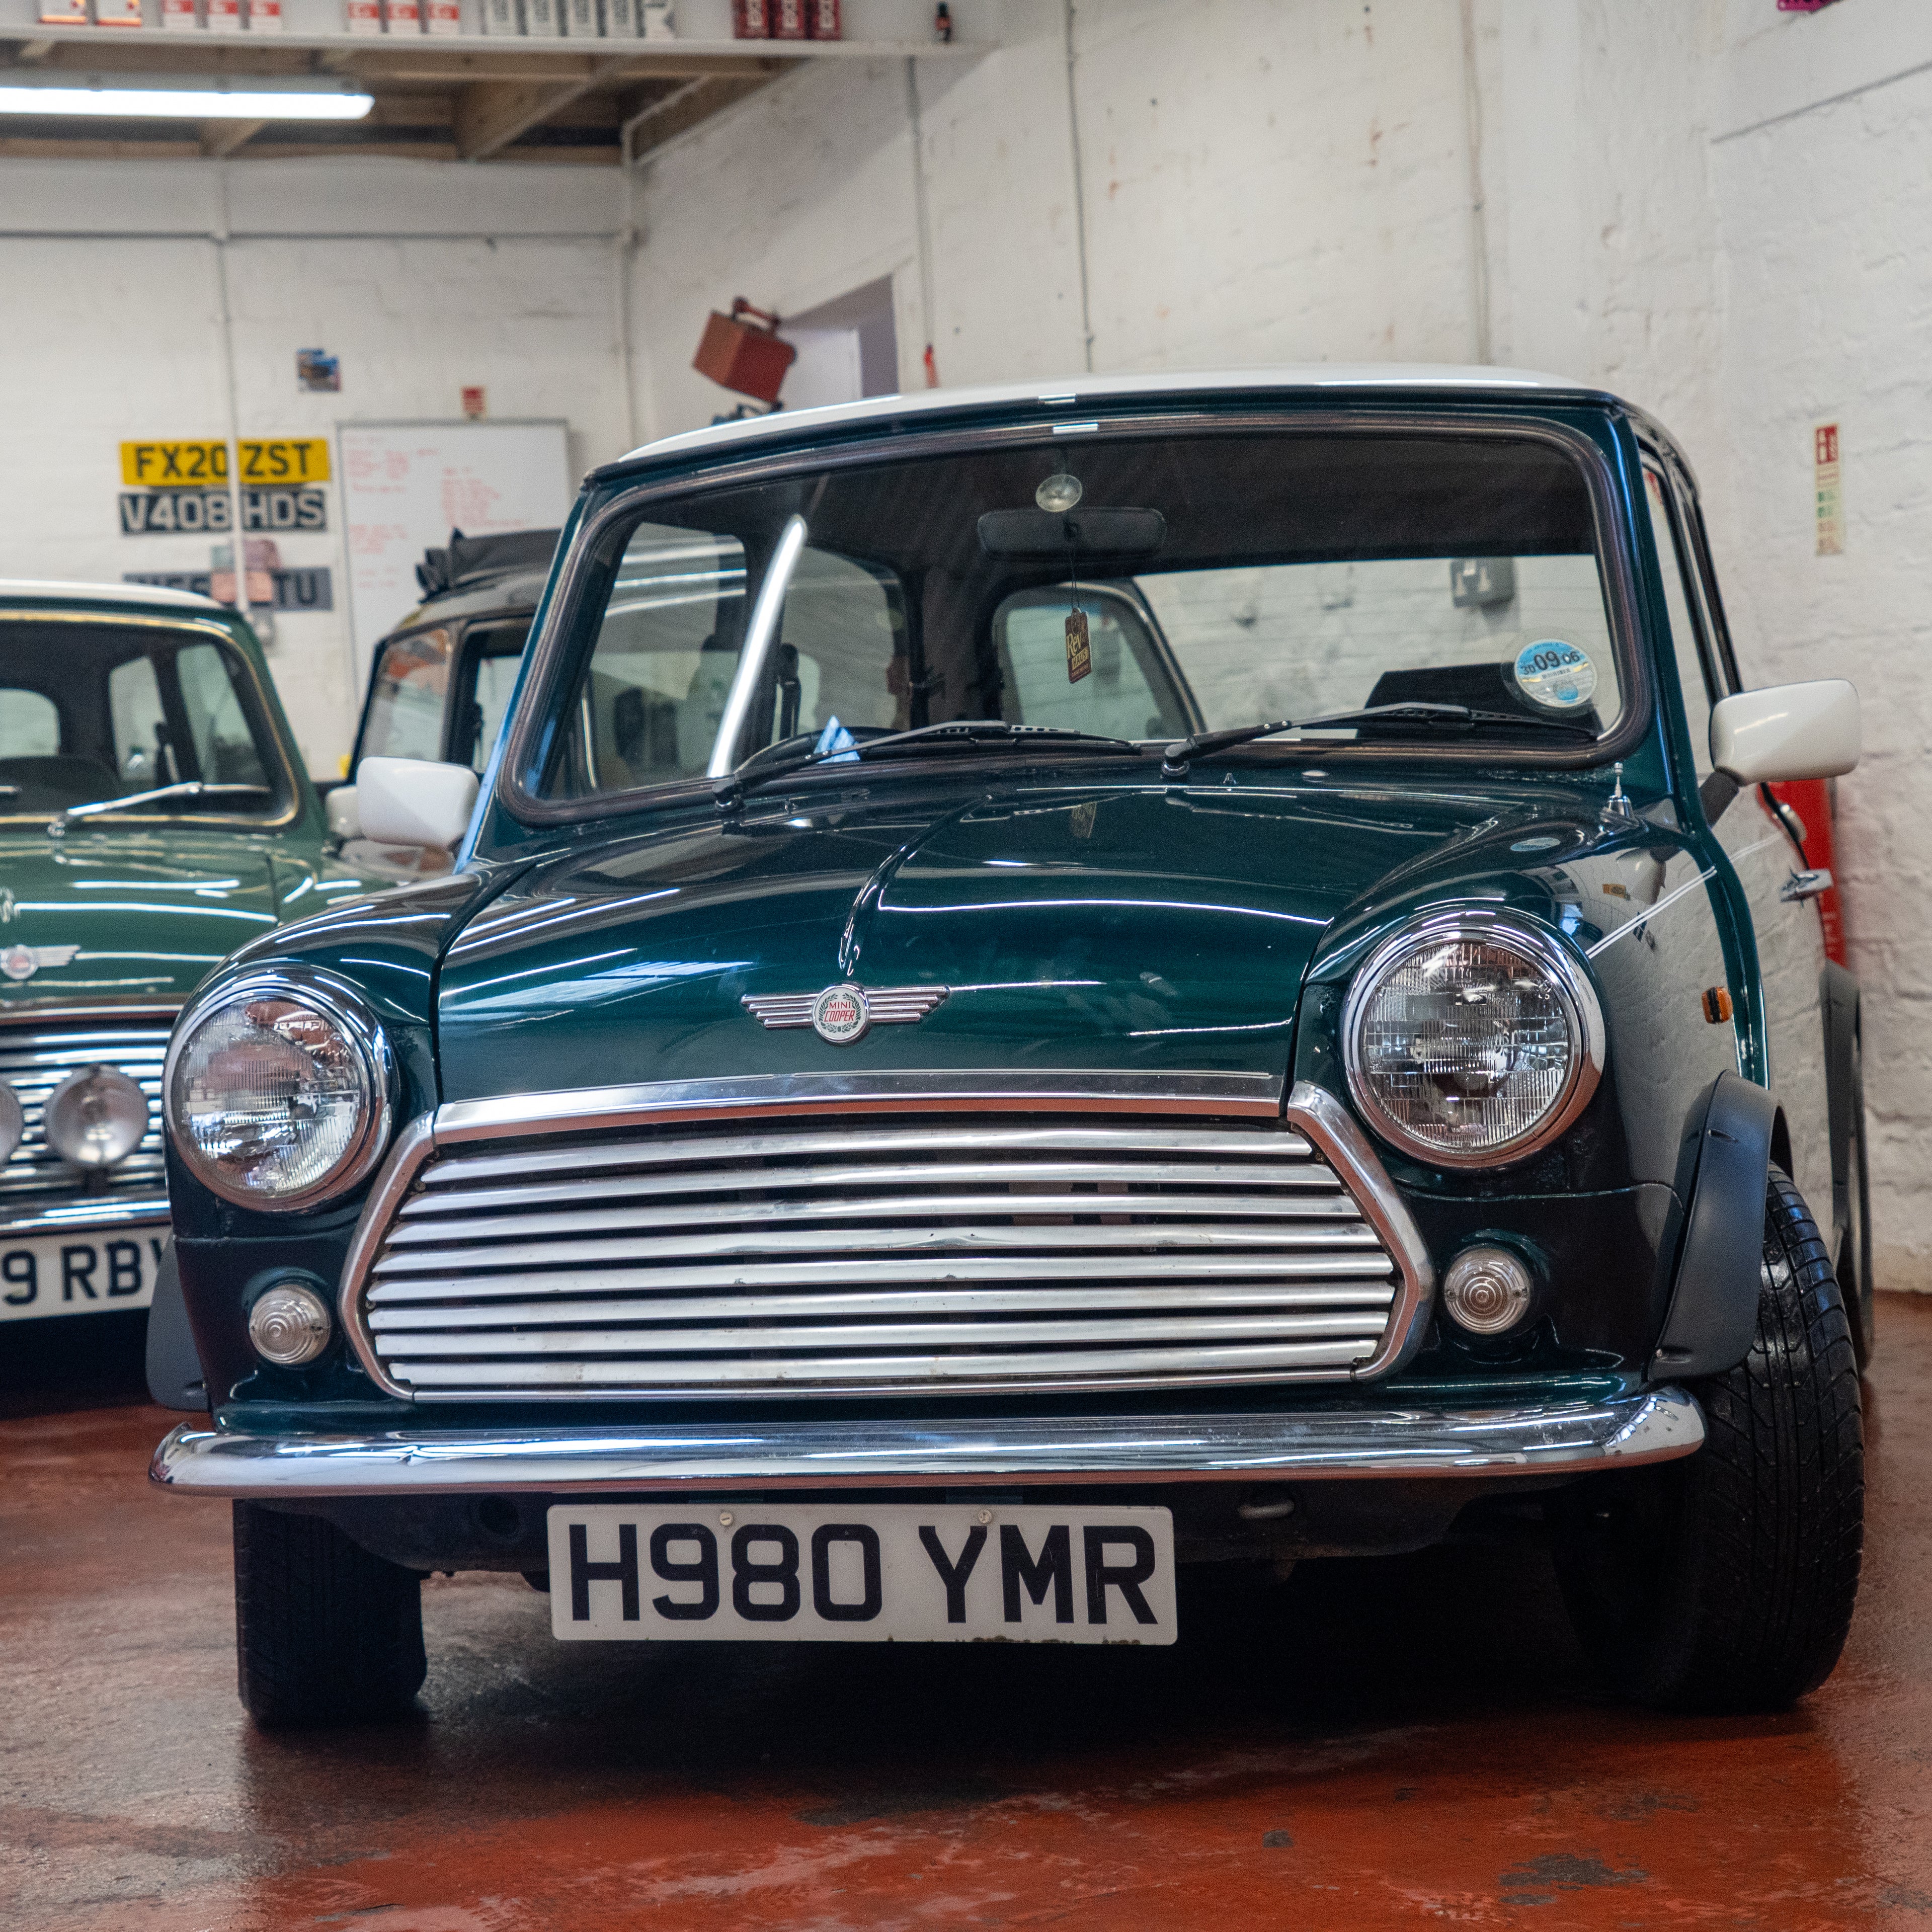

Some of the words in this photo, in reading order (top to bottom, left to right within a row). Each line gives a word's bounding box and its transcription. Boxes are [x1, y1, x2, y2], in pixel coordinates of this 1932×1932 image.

[244, 443, 312, 477] ZST
[122, 495, 231, 531] V408
[1534, 651, 1560, 670] 09
[1562, 651, 1580, 664] 06
[824, 1010, 855, 1022] COOPER
[569, 1523, 883, 1622] H980
[918, 1525, 1158, 1625] YMR
